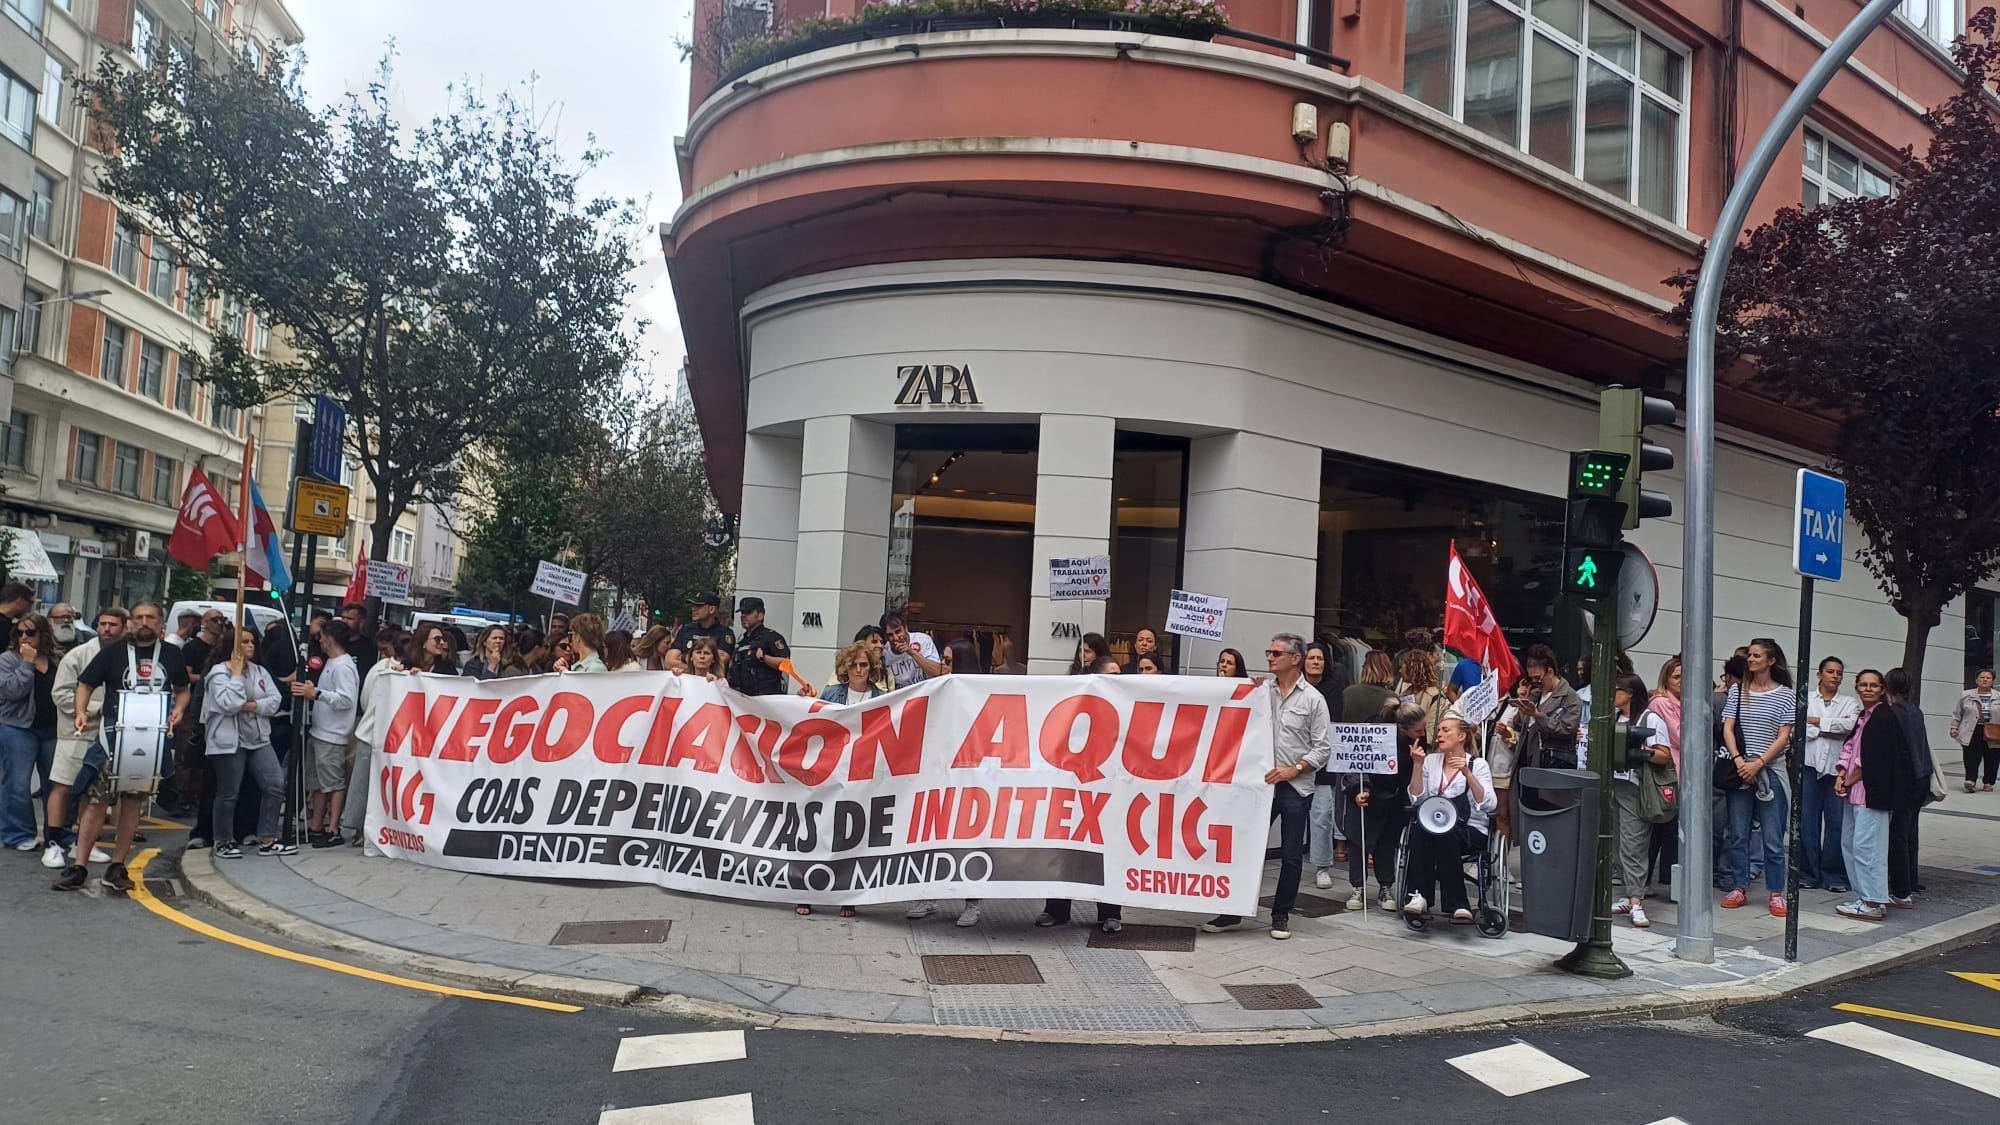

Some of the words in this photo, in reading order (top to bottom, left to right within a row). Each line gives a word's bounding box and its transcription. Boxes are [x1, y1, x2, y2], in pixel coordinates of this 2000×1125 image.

[894, 363, 984, 405] ZARA
[1803, 507, 1843, 544] TAXI
[1071, 557, 1091, 567] AQUÍ
[548, 572, 572, 584] INDITEX
[1052, 568, 1108, 576] TRABALLAMOS
[1055, 588, 1110, 597] NEGOCIAMOS!
[1189, 595, 1209, 605] AQUÍ
[1172, 602, 1224, 617] TRABALLAMOS
[802, 612, 823, 628] ZARA
[1051, 621, 1082, 638] ZARA
[1170, 623, 1221, 638] NEGOCIAMOS!
[951, 684, 1256, 784] AQUÍ
[1335, 726, 1359, 734] NON
[1362, 726, 1388, 735] IMOS
[383, 691, 929, 787] NEGOCIACIÓN
[1340, 735, 1383, 744] PARAR...
[1353, 744, 1373, 752] ATA
[1336, 753, 1388, 761] NEGOCIAR
[1349, 761, 1375, 771] AQUÍ
[380, 765, 435, 825] CIG
[456, 777, 541, 825] COAS
[546, 778, 823, 854] DEPENDENTAS
[832, 795, 896, 853] DE
[907, 786, 1112, 845] INDITEX
[1126, 791, 1233, 864] CIG
[378, 826, 426, 853] SERVIZOS
[498, 834, 608, 865] DENDE
[716, 853, 793, 890] PARA
[804, 863, 836, 892] O
[852, 851, 993, 890] MUNDO
[1126, 868, 1231, 899] SERVIZOS
